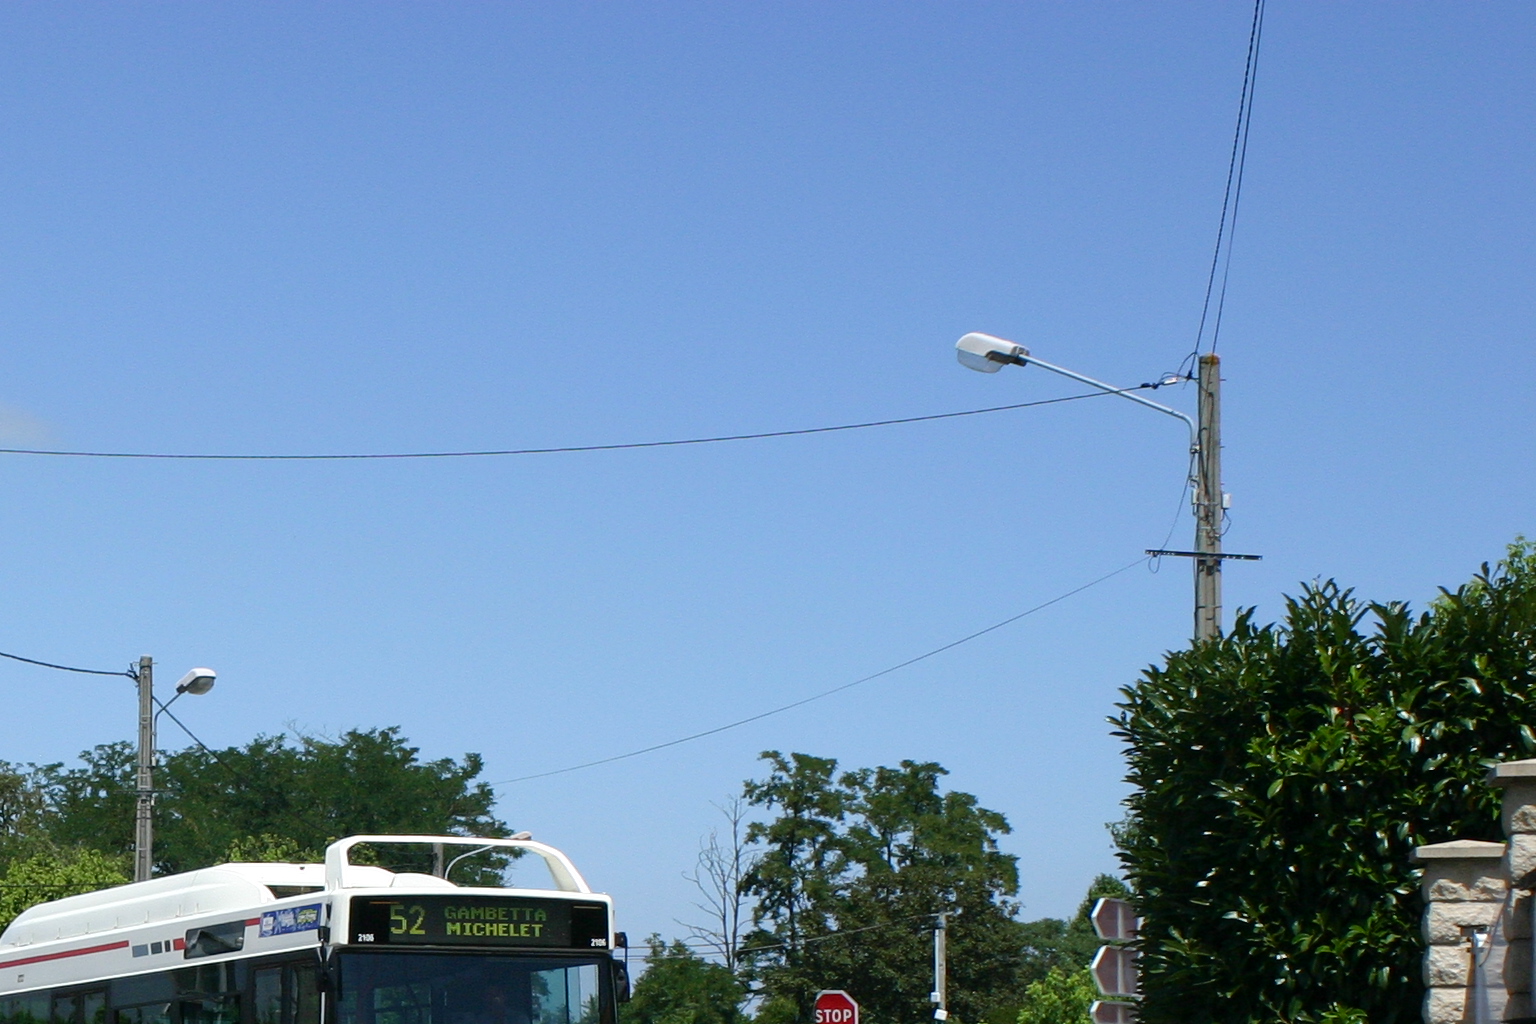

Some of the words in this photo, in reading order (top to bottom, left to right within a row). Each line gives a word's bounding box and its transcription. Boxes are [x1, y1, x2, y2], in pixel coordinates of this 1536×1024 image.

[390, 904, 426, 935] 52
[444, 906, 547, 921] GAMBETTA
[446, 922, 544, 937] MICHELET
[815, 1008, 853, 1024] STOP
